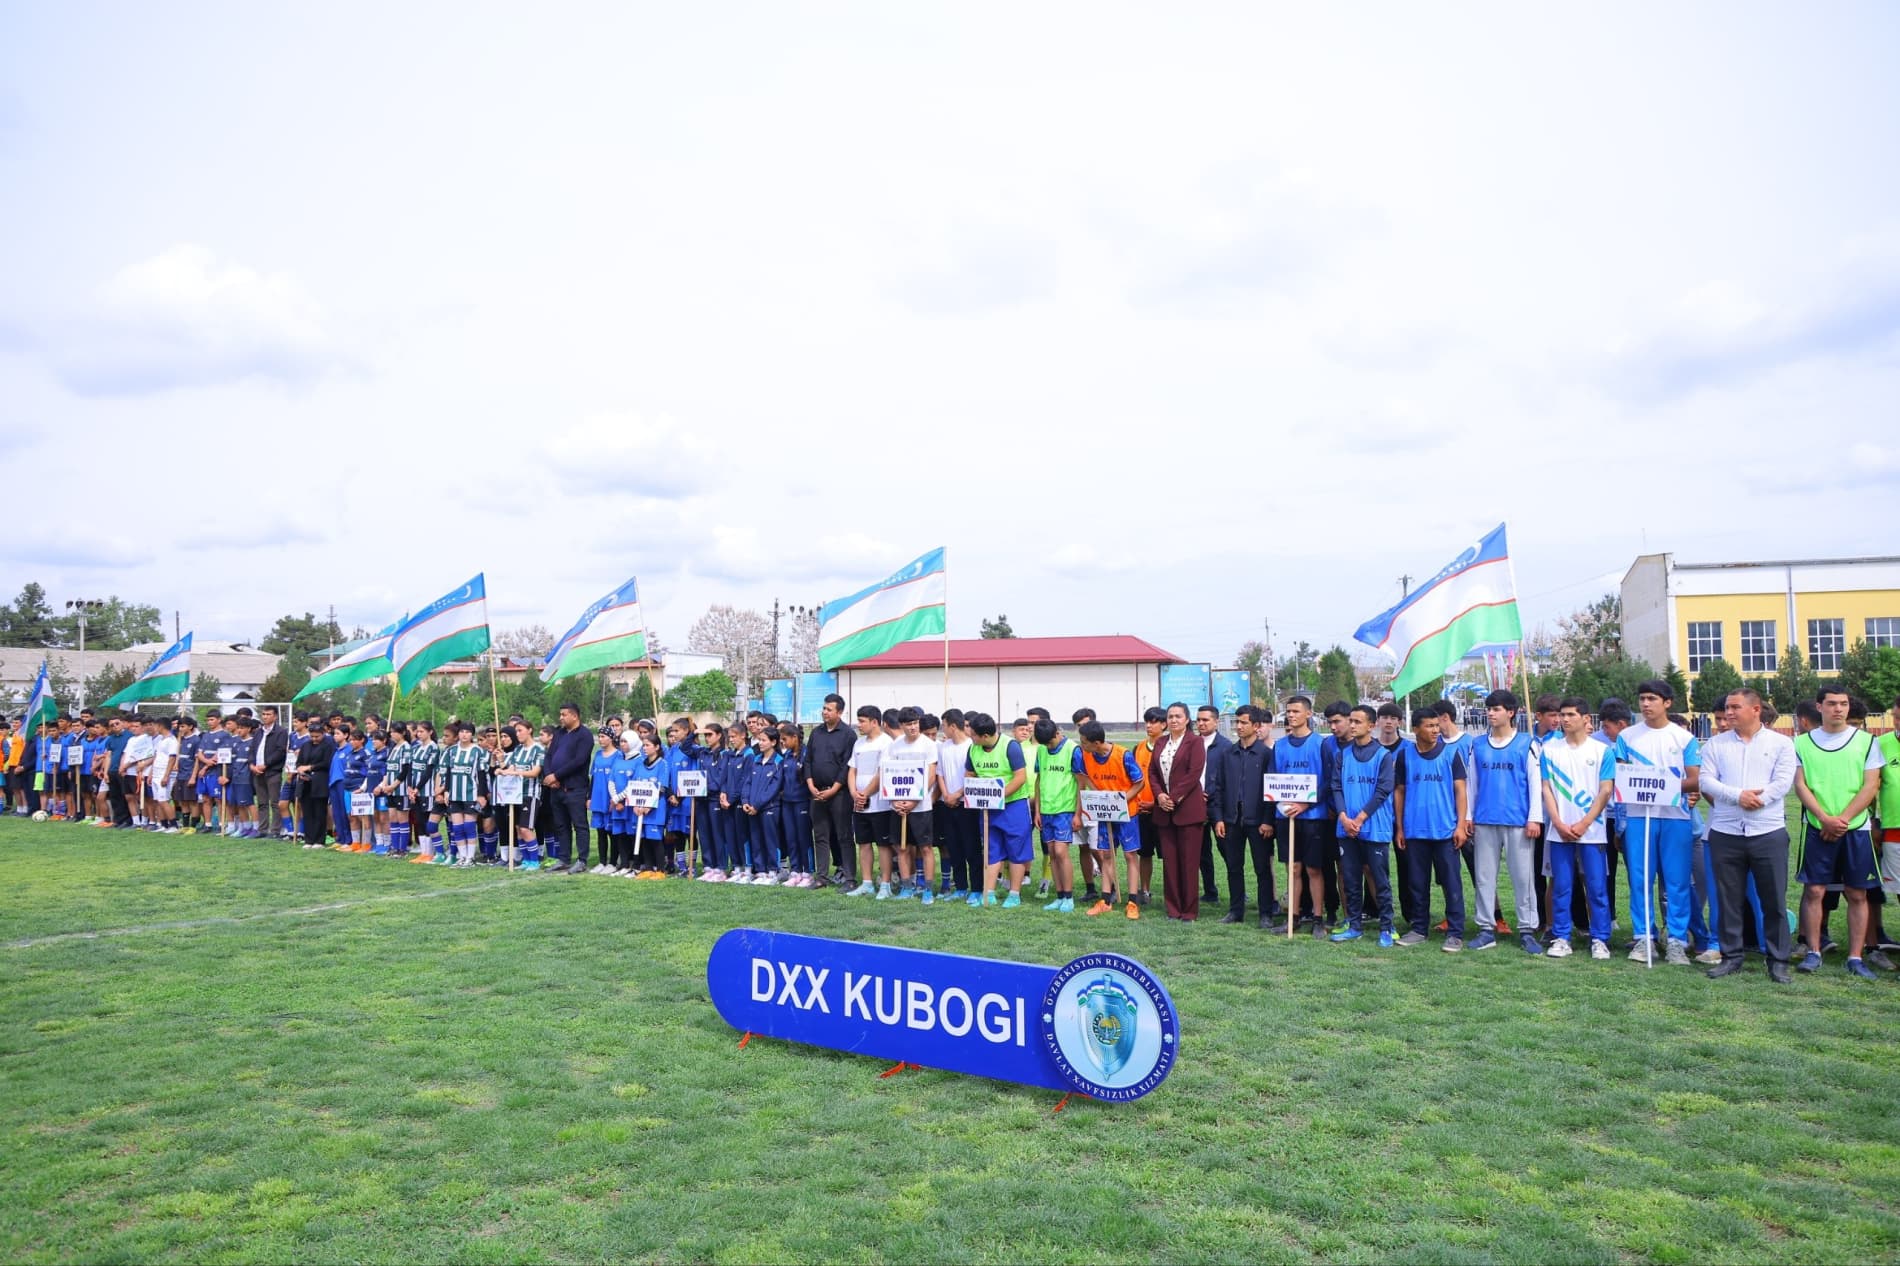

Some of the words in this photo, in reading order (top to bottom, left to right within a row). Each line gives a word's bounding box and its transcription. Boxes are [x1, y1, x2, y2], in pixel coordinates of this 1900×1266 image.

[982, 761, 999, 769] JAKO
[1491, 762, 1514, 771] JAKO
[891, 776, 914, 785] OBOD
[1628, 777, 1666, 790] ITTIFOQ
[1269, 783, 1310, 791] HURRIYAT
[894, 788, 911, 797] MFY
[1636, 791, 1657, 803] MFY
[976, 799, 990, 808] MFY
[1087, 804, 1121, 812] ISTIQLOL
[1105, 958, 1170, 1022] RESPUBLIKASI
[751, 957, 830, 1014] DXX
[843, 971, 1026, 1047] KUBOGI
[1046, 1032, 1073, 1076] DAVLAT
[1072, 1074, 1138, 1100] XAVFSIZLIK
[1138, 1051, 1170, 1093] XIZMATI
